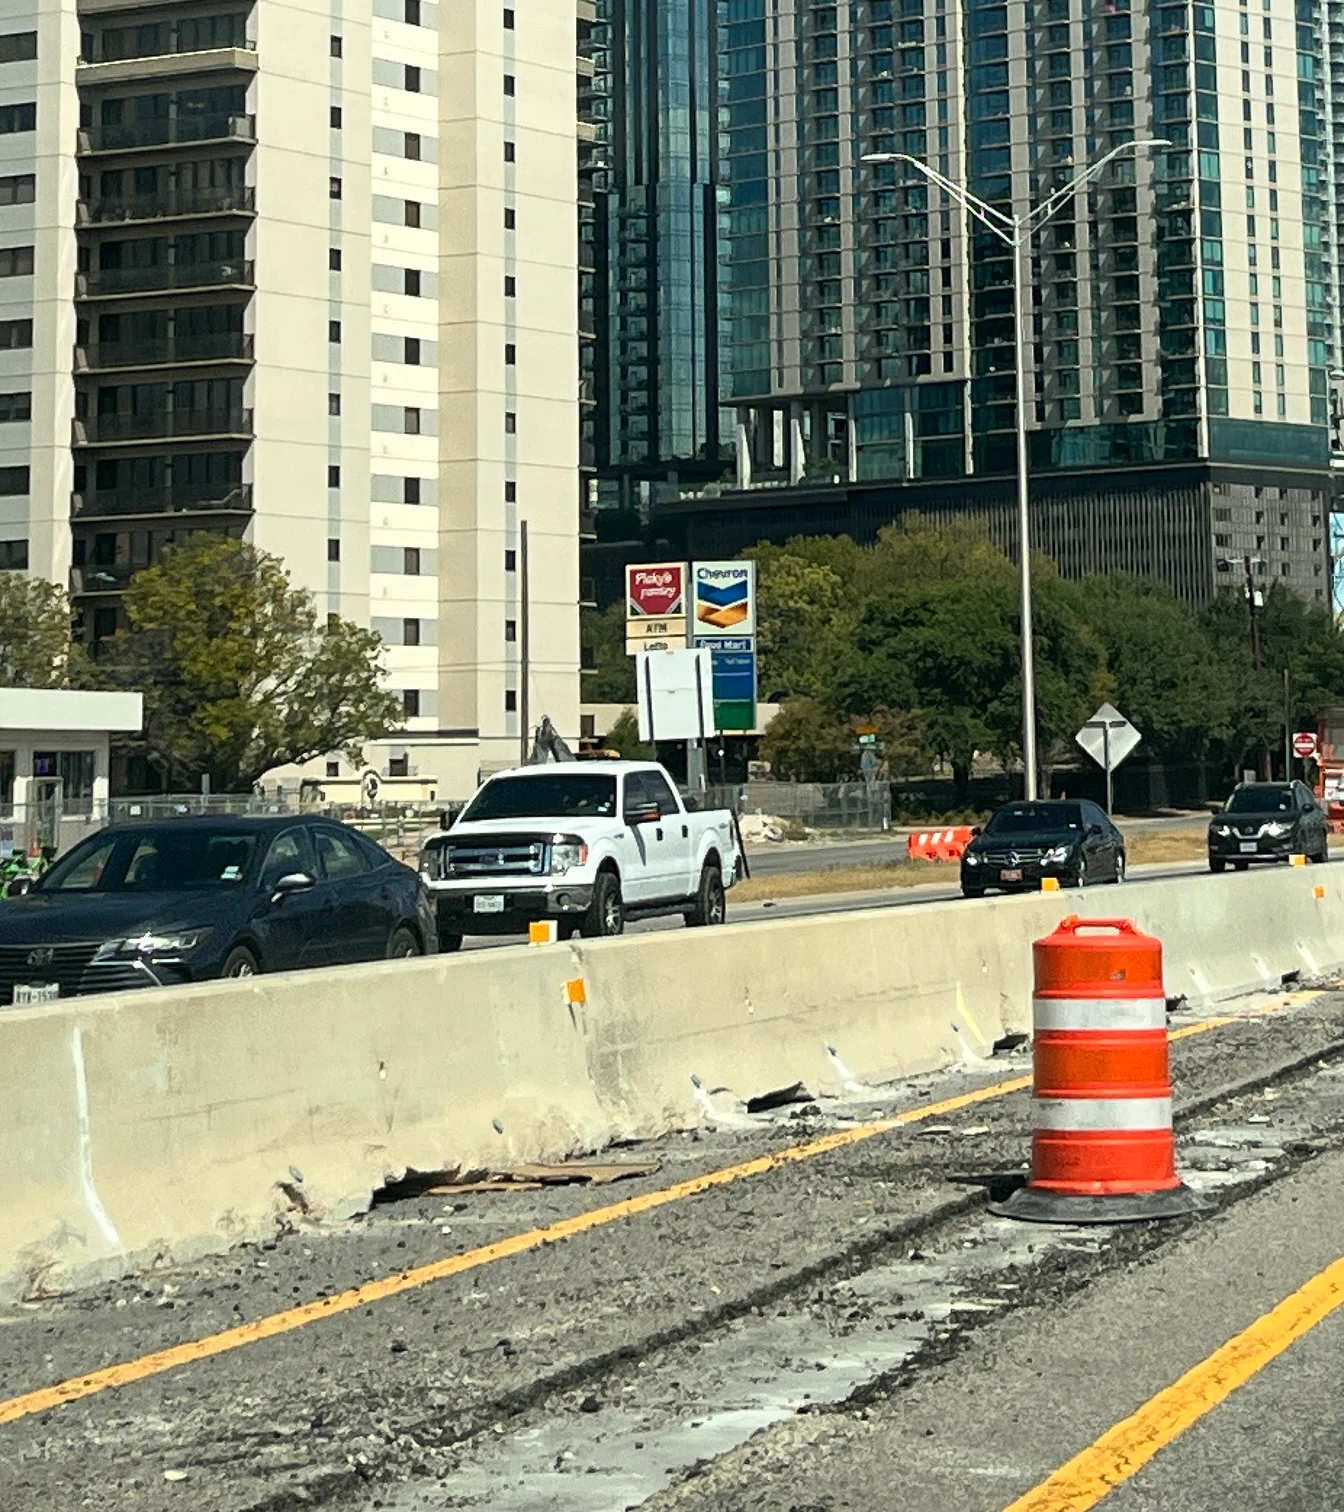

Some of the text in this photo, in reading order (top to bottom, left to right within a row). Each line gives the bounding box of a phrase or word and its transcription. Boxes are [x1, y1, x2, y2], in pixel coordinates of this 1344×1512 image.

[697, 567, 748, 579] Chevron
[646, 623, 668, 633] ATM
[723, 639, 746, 648] Mart
